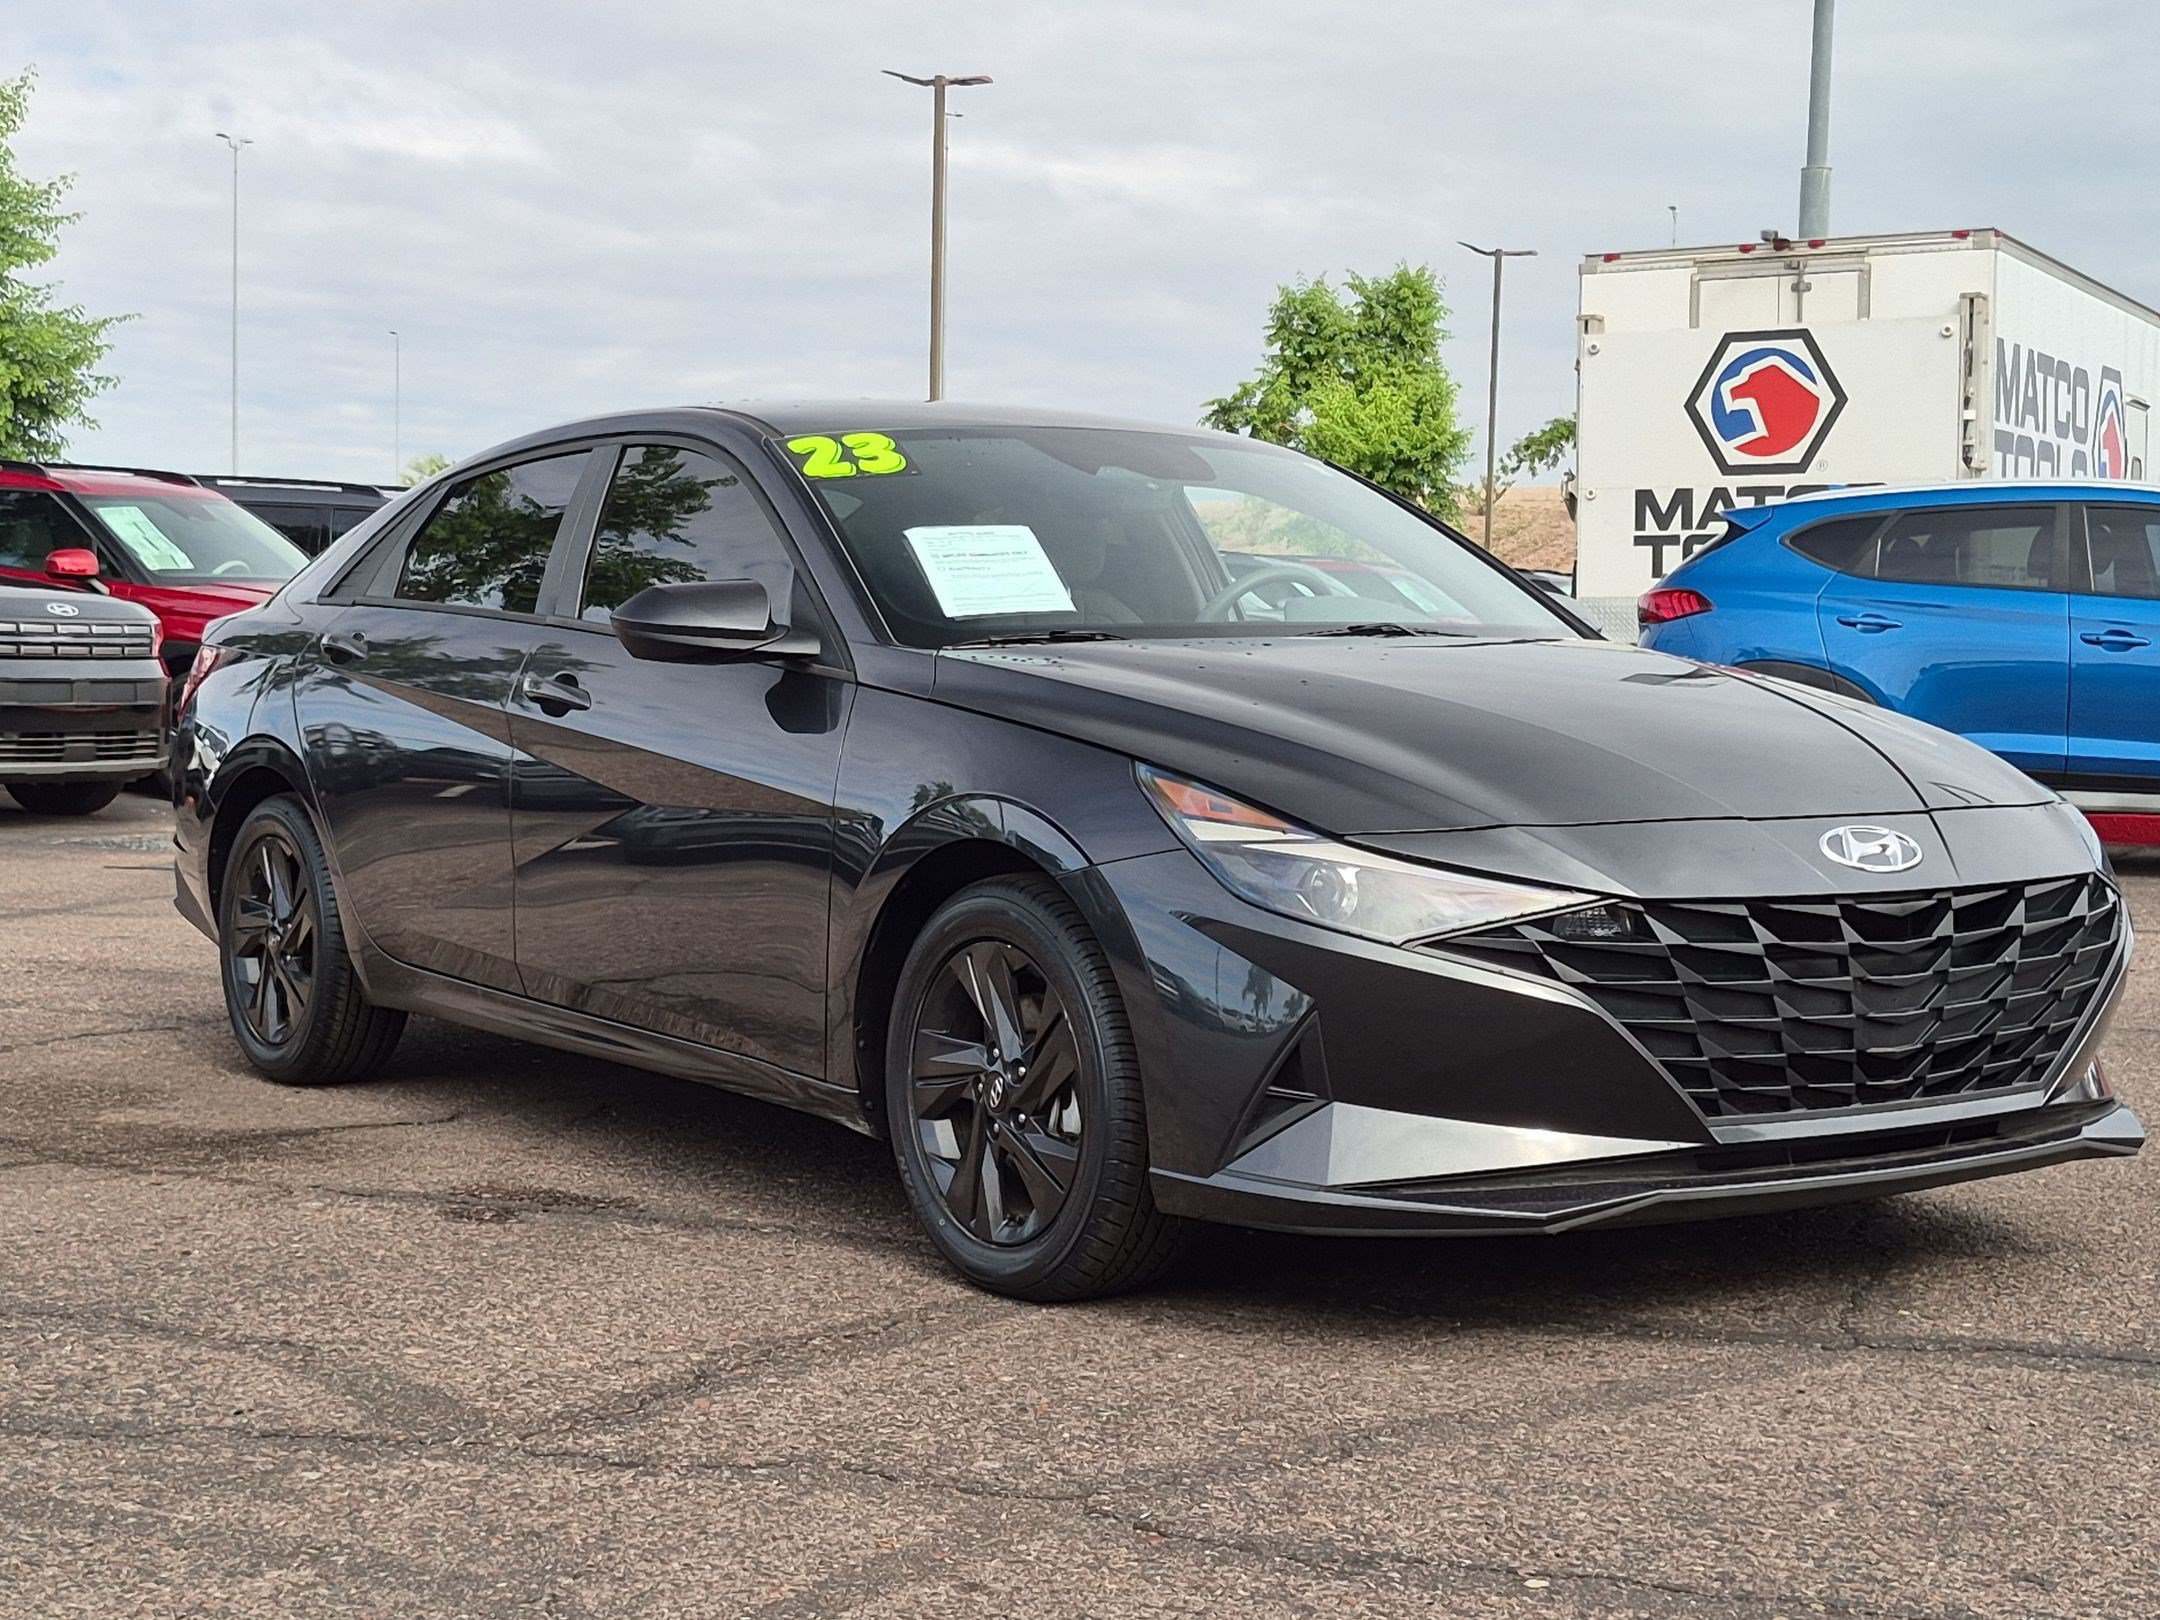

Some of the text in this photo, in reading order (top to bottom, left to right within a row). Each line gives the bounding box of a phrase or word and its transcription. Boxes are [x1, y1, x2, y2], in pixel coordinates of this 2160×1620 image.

[1995, 336, 2090, 445] MATCO
[786, 432, 907, 478] 23
[1634, 482, 1888, 532] MAT
